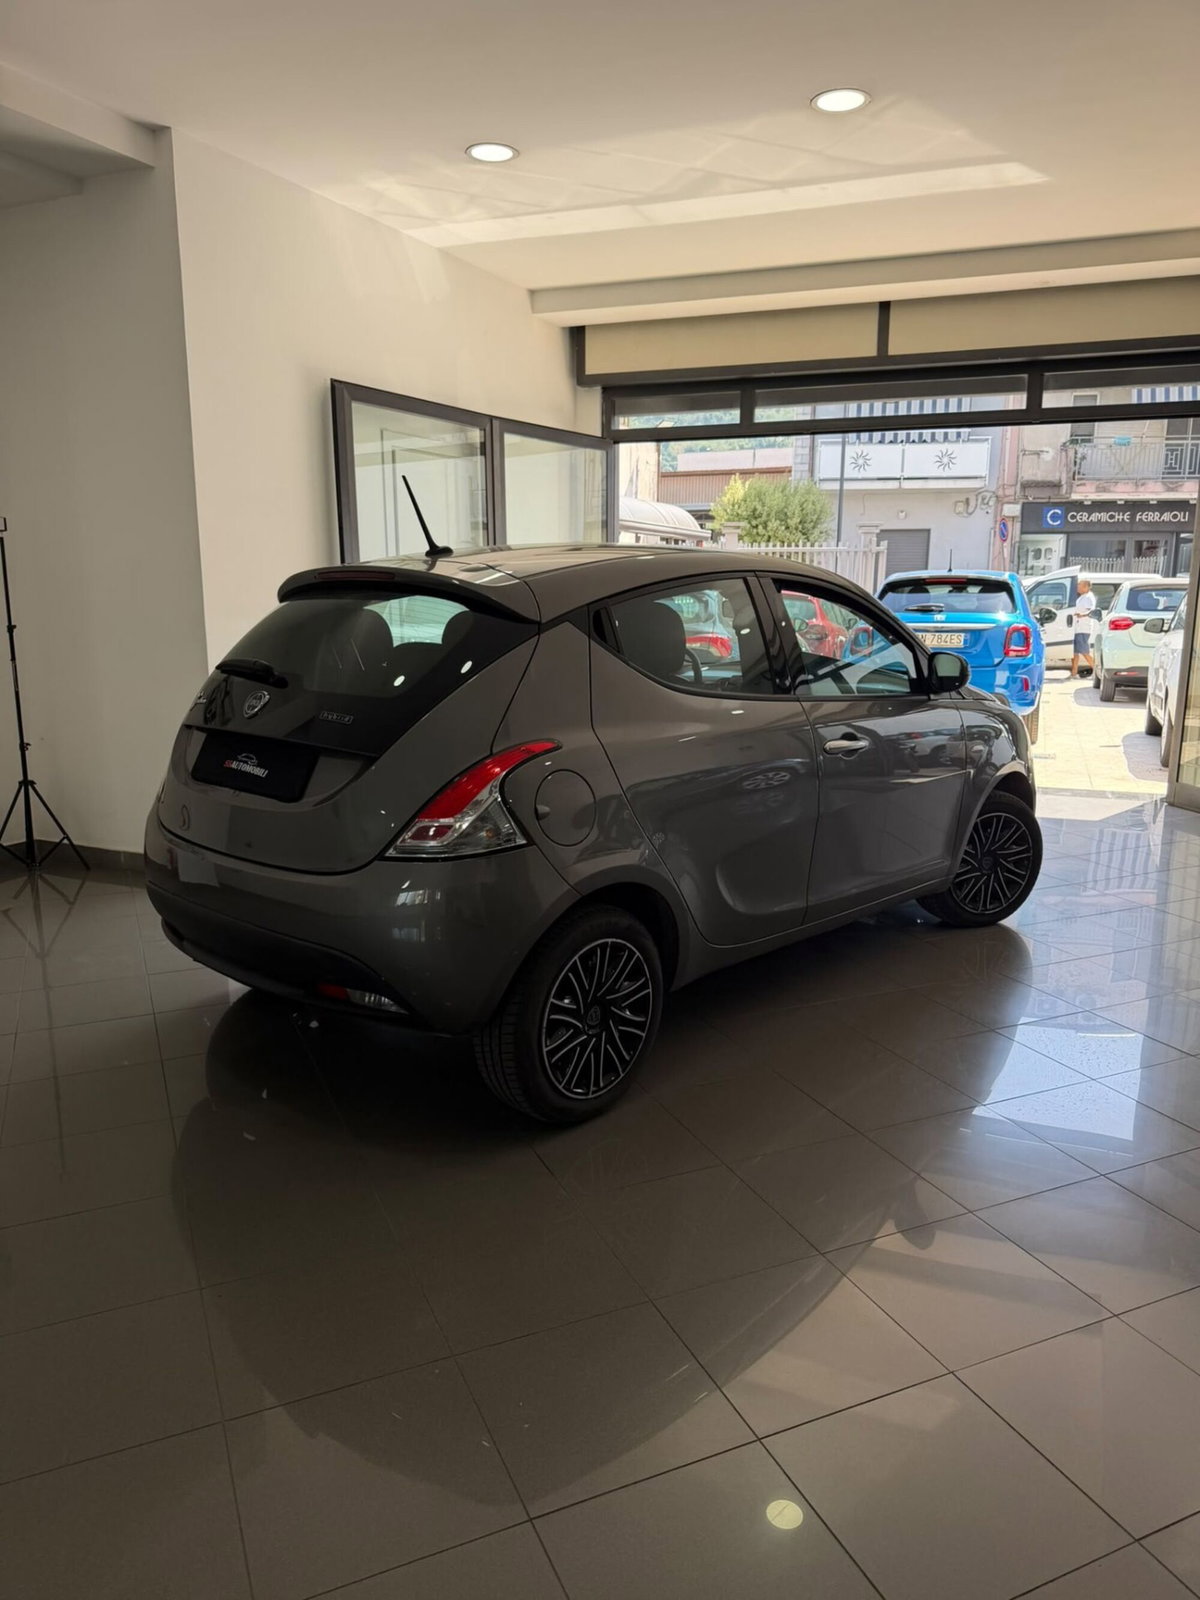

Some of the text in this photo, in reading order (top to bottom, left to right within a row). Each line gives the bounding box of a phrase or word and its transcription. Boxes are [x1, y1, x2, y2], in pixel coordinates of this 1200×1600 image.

[1046, 509, 1189, 526] C CERAMICHE FERRAIOLI
[929, 633, 963, 645] 784ES
